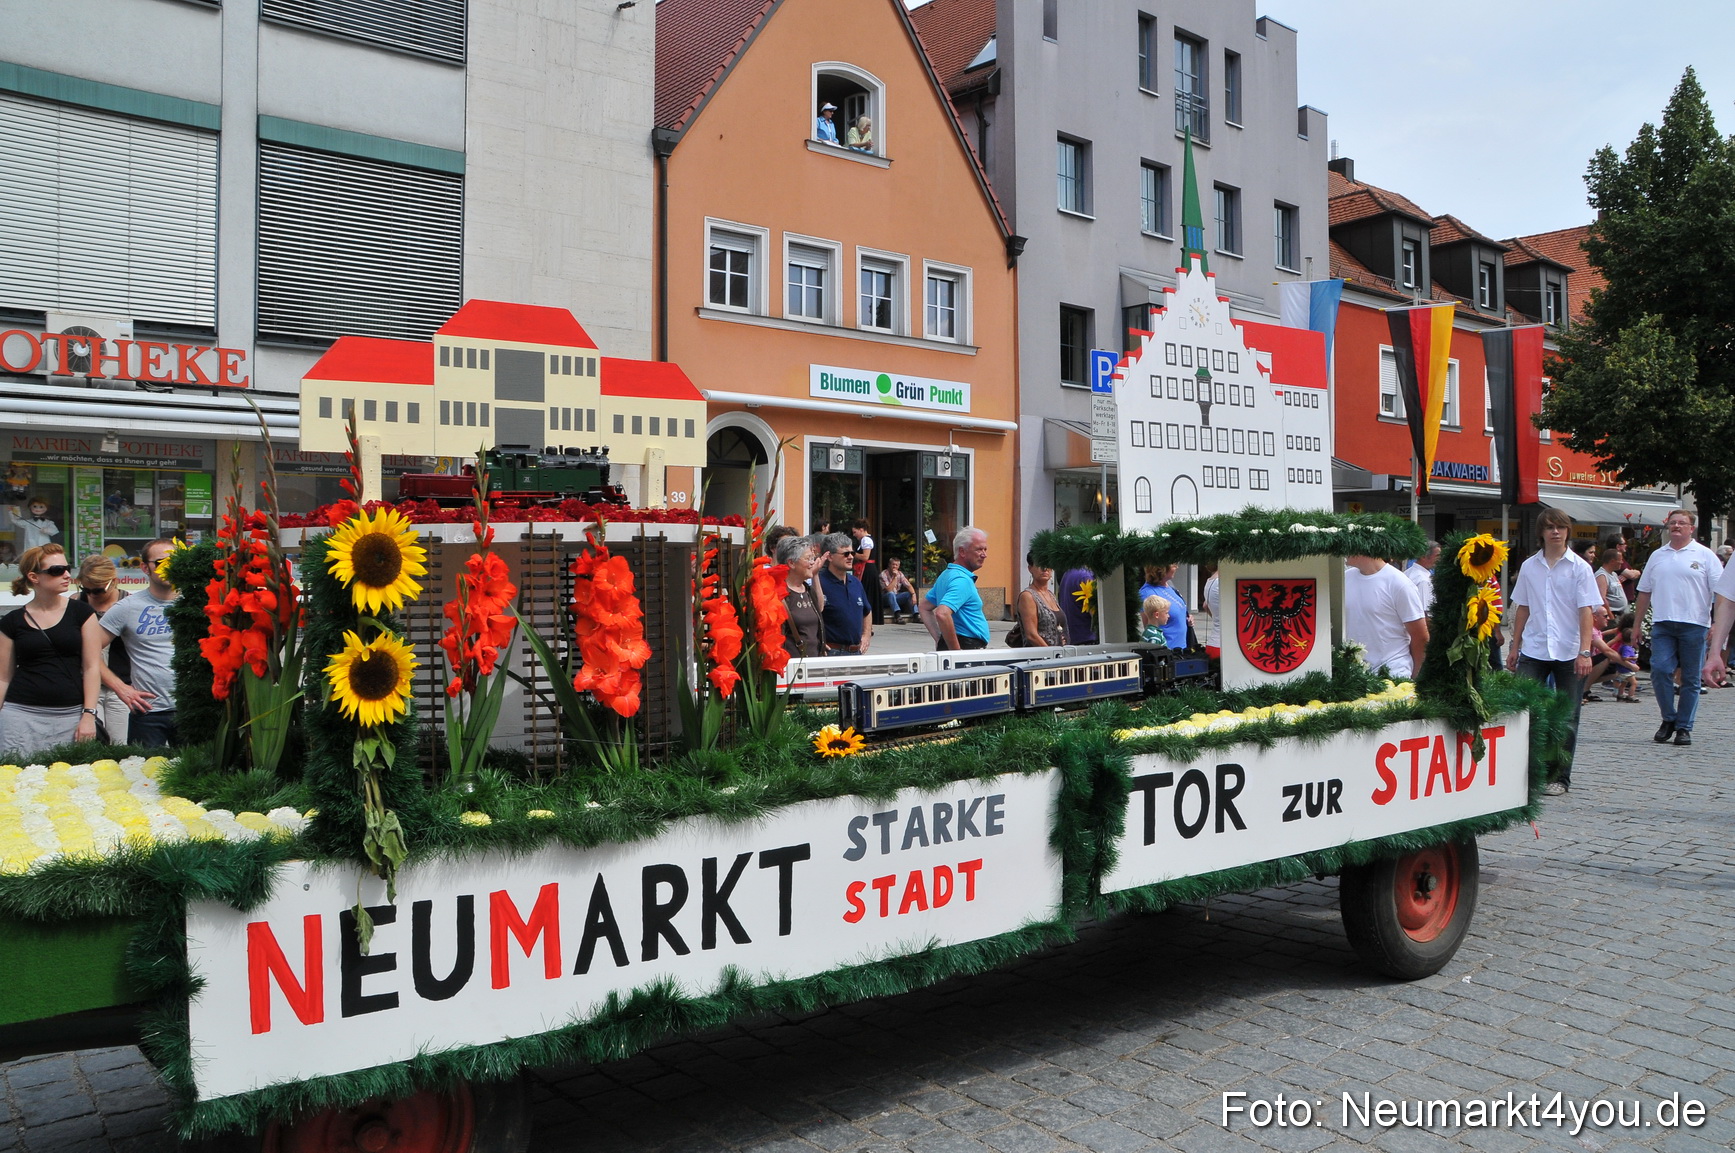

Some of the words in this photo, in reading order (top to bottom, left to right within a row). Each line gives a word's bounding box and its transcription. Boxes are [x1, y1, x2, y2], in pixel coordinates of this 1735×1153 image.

[1097, 355, 1113, 388] P
[820, 372, 871, 395] Blumen
[896, 381, 925, 401] Grün
[930, 385, 964, 406] Punkt
[1093, 404, 1116, 412] Parkschei
[12, 436, 91, 452] MARIEN
[119, 441, 204, 458] POTHEKE
[61, 454, 95, 463] möchten,
[96, 456, 113, 464] dass
[146, 459, 158, 467] gut
[159, 459, 177, 467] geht!
[671, 491, 686, 503] 39
[1130, 764, 1247, 845] TOR
[1282, 778, 1343, 823] ZUR
[1371, 725, 1506, 806] STADT
[844, 793, 1006, 862] STARKE
[843, 859, 982, 924] STADT
[247, 842, 811, 1034] NEUMARKT
